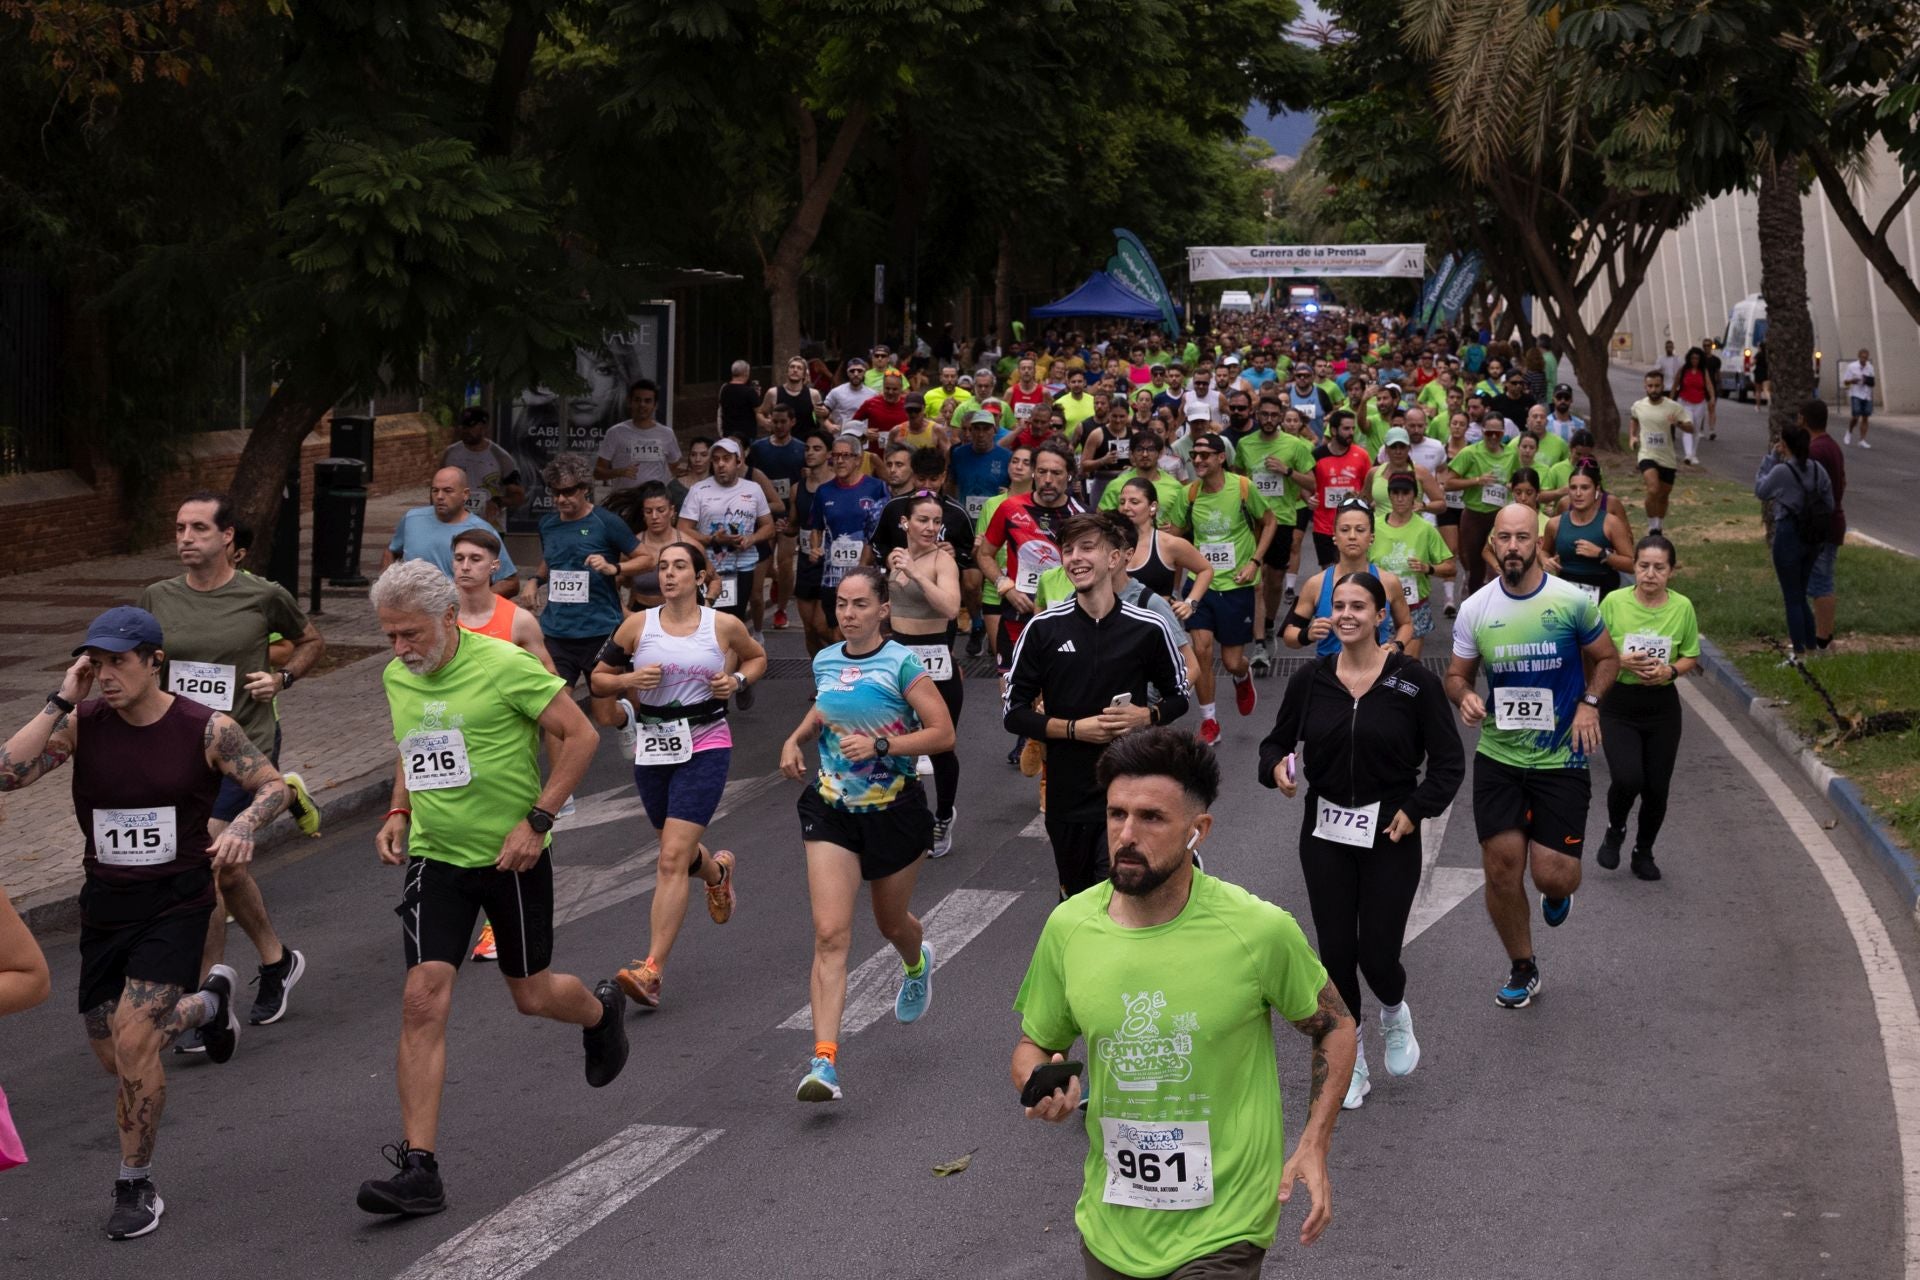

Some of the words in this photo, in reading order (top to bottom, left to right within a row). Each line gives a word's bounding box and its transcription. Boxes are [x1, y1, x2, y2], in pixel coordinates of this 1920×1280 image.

[1250, 248, 1293, 258] Carrera
[1296, 248, 1312, 257] de
[1314, 248, 1325, 257] la
[1327, 247, 1367, 257] Prensa
[571, 439, 600, 449] ANTI-
[634, 446, 659, 454] 1112
[1256, 481, 1278, 490] 397
[834, 550, 858, 559] 419
[1205, 552, 1229, 562] 482
[553, 581, 583, 591] 1037
[1494, 645, 1505, 658] IV
[1506, 640, 1557, 657] TRIATLÓN
[923, 657, 943, 670] 17
[1517, 659, 1530, 673] DE
[1531, 657, 1563, 672] MIJAS
[176, 677, 226, 694] 1206
[1503, 702, 1543, 716] 787
[644, 736, 682, 752] 258
[412, 750, 455, 773] 216
[1322, 807, 1369, 830] 1772
[105, 828, 160, 848] 115
[1099, 1038, 1175, 1059] Carrera
[1112, 1054, 1183, 1073] Prensa
[1127, 1127, 1173, 1141] Carrera
[1137, 1140, 1178, 1150] Prensa
[1117, 1149, 1187, 1182] 961
